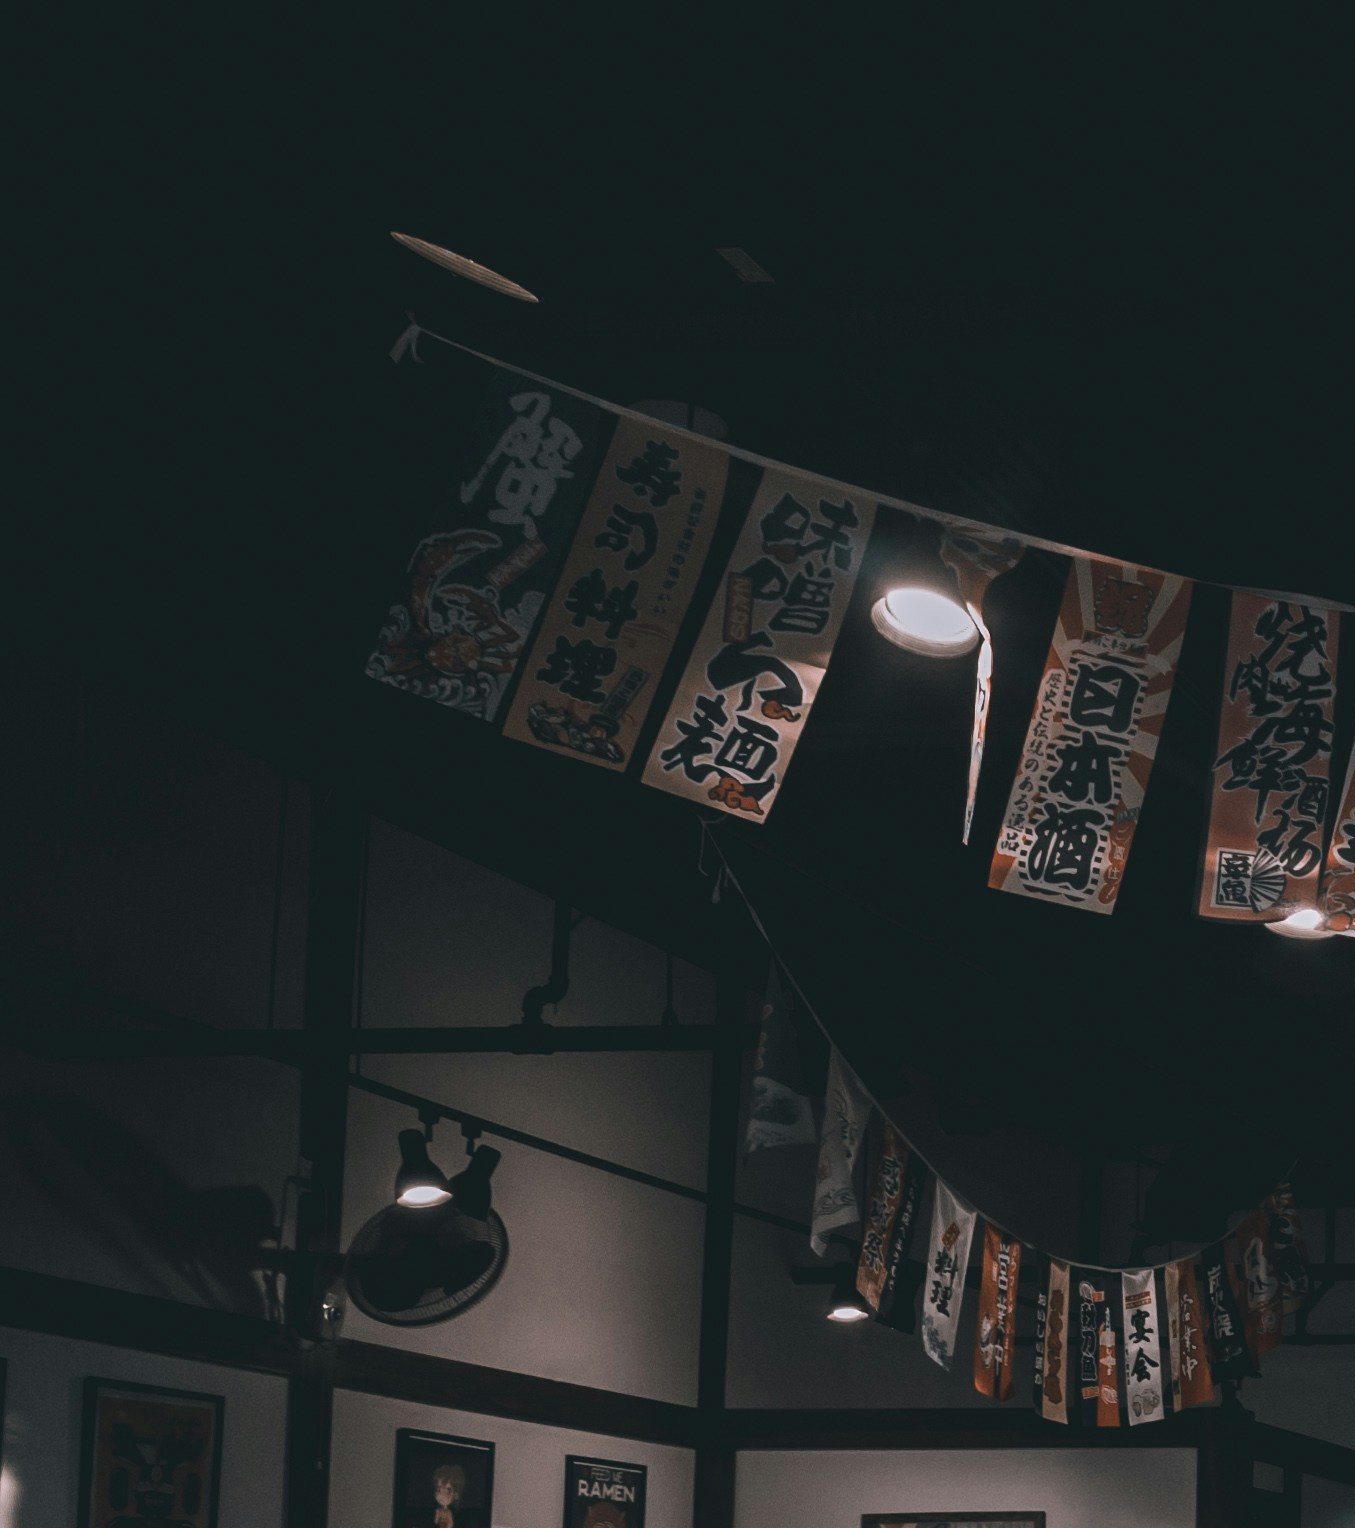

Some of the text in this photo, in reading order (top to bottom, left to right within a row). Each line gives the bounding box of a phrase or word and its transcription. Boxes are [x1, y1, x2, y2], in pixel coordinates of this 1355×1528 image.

[1020, 660, 1143, 892] 日本酒
[1128, 1309, 1160, 1383] 宴会
[577, 1479, 635, 1502] RAMEN
